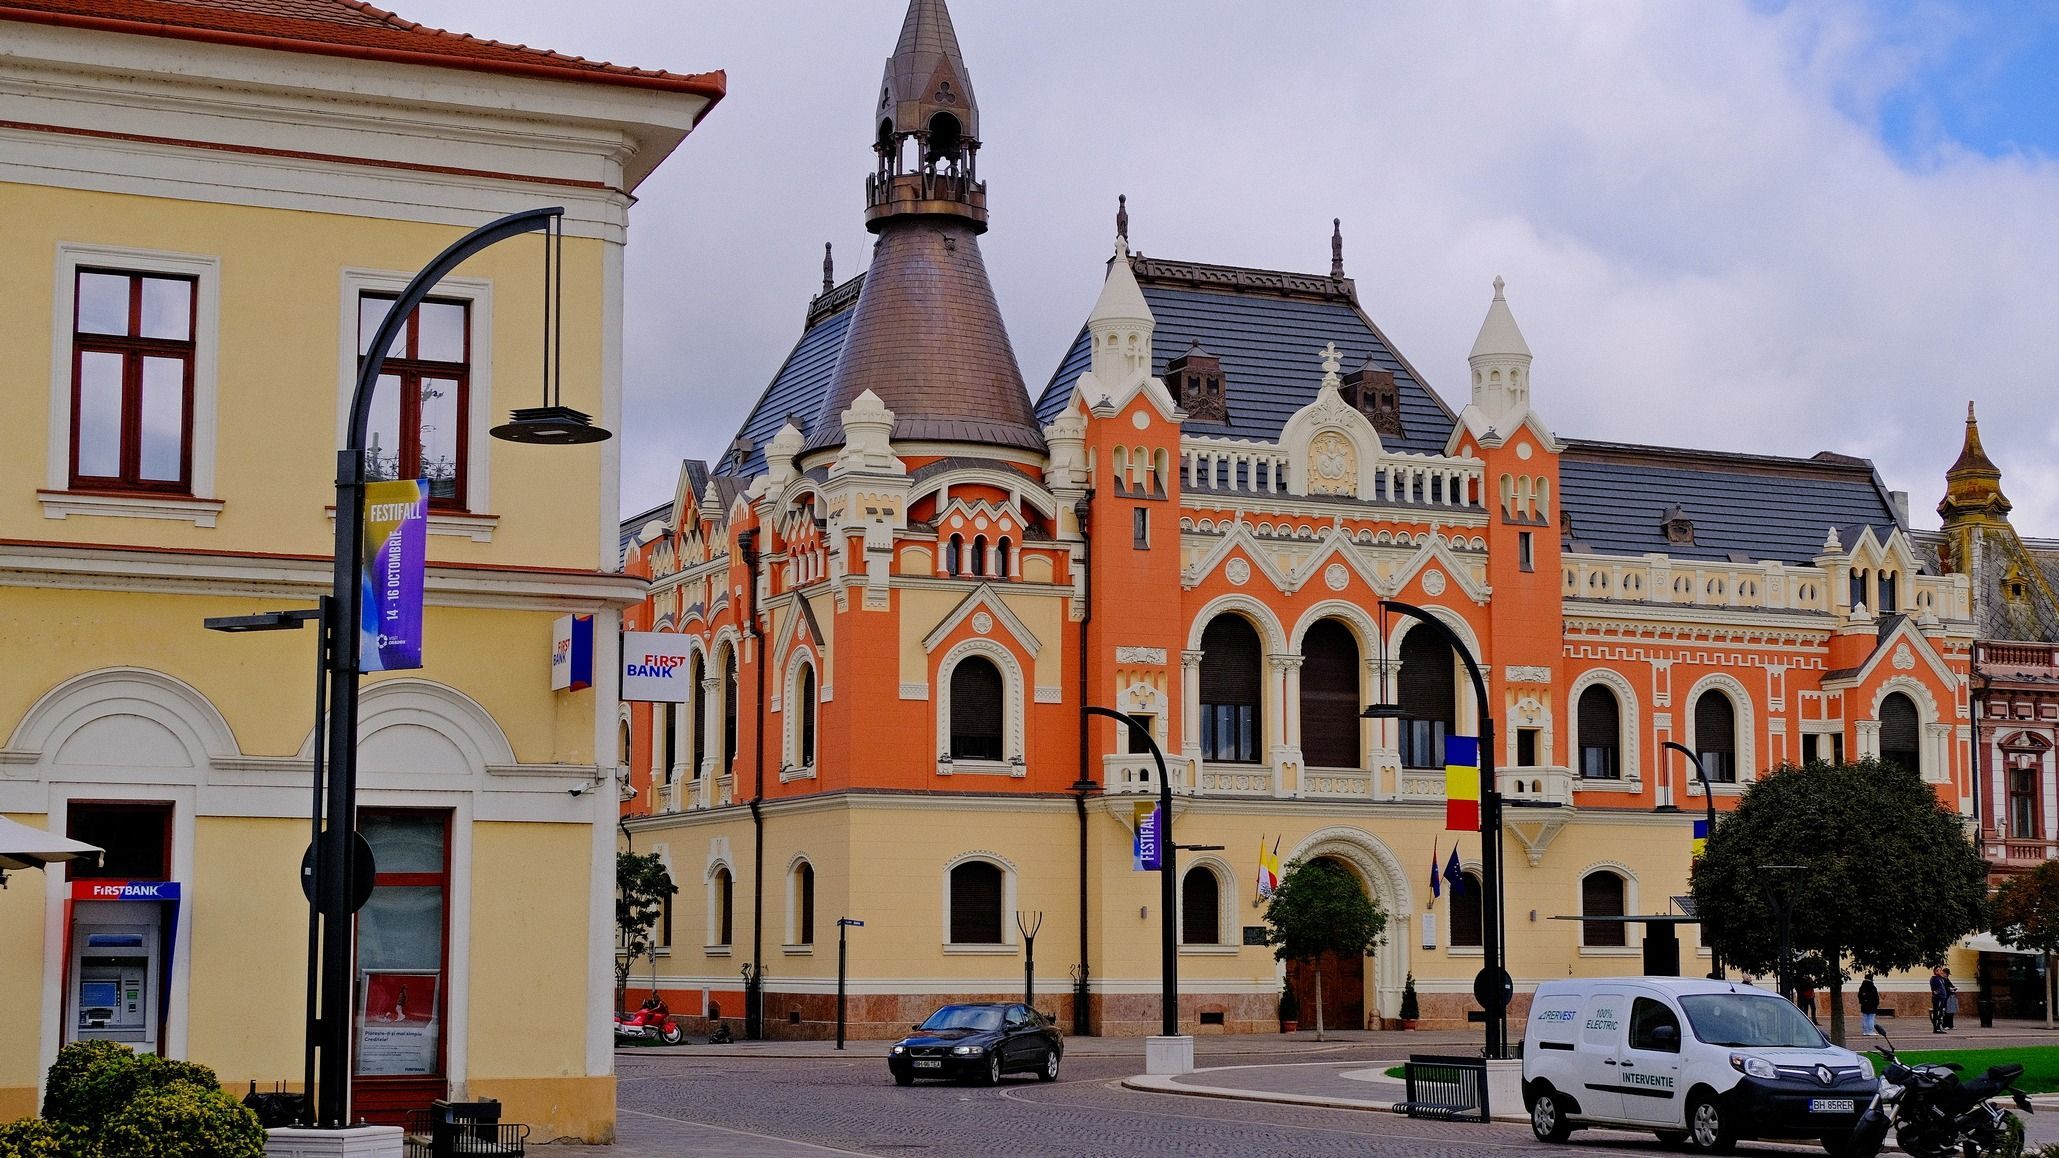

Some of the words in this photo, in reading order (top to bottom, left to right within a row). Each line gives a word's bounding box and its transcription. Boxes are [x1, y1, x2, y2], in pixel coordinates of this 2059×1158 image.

[371, 503, 421, 522] FESTIFALL
[387, 530, 402, 587] OCTOMBRIE
[387, 589, 400, 601] 16
[387, 609, 399, 621] 14
[553, 654, 567, 667] BANK
[644, 654, 686, 668] FIRST
[627, 664, 673, 679] BANK
[1140, 811, 1154, 860] FESTIFALL
[1596, 1008, 1614, 1019] 100%
[1586, 1019, 1619, 1031] ELECTRIC
[1622, 1072, 1674, 1087] INTERVENTIE
[1813, 1100, 1826, 1110] BH
